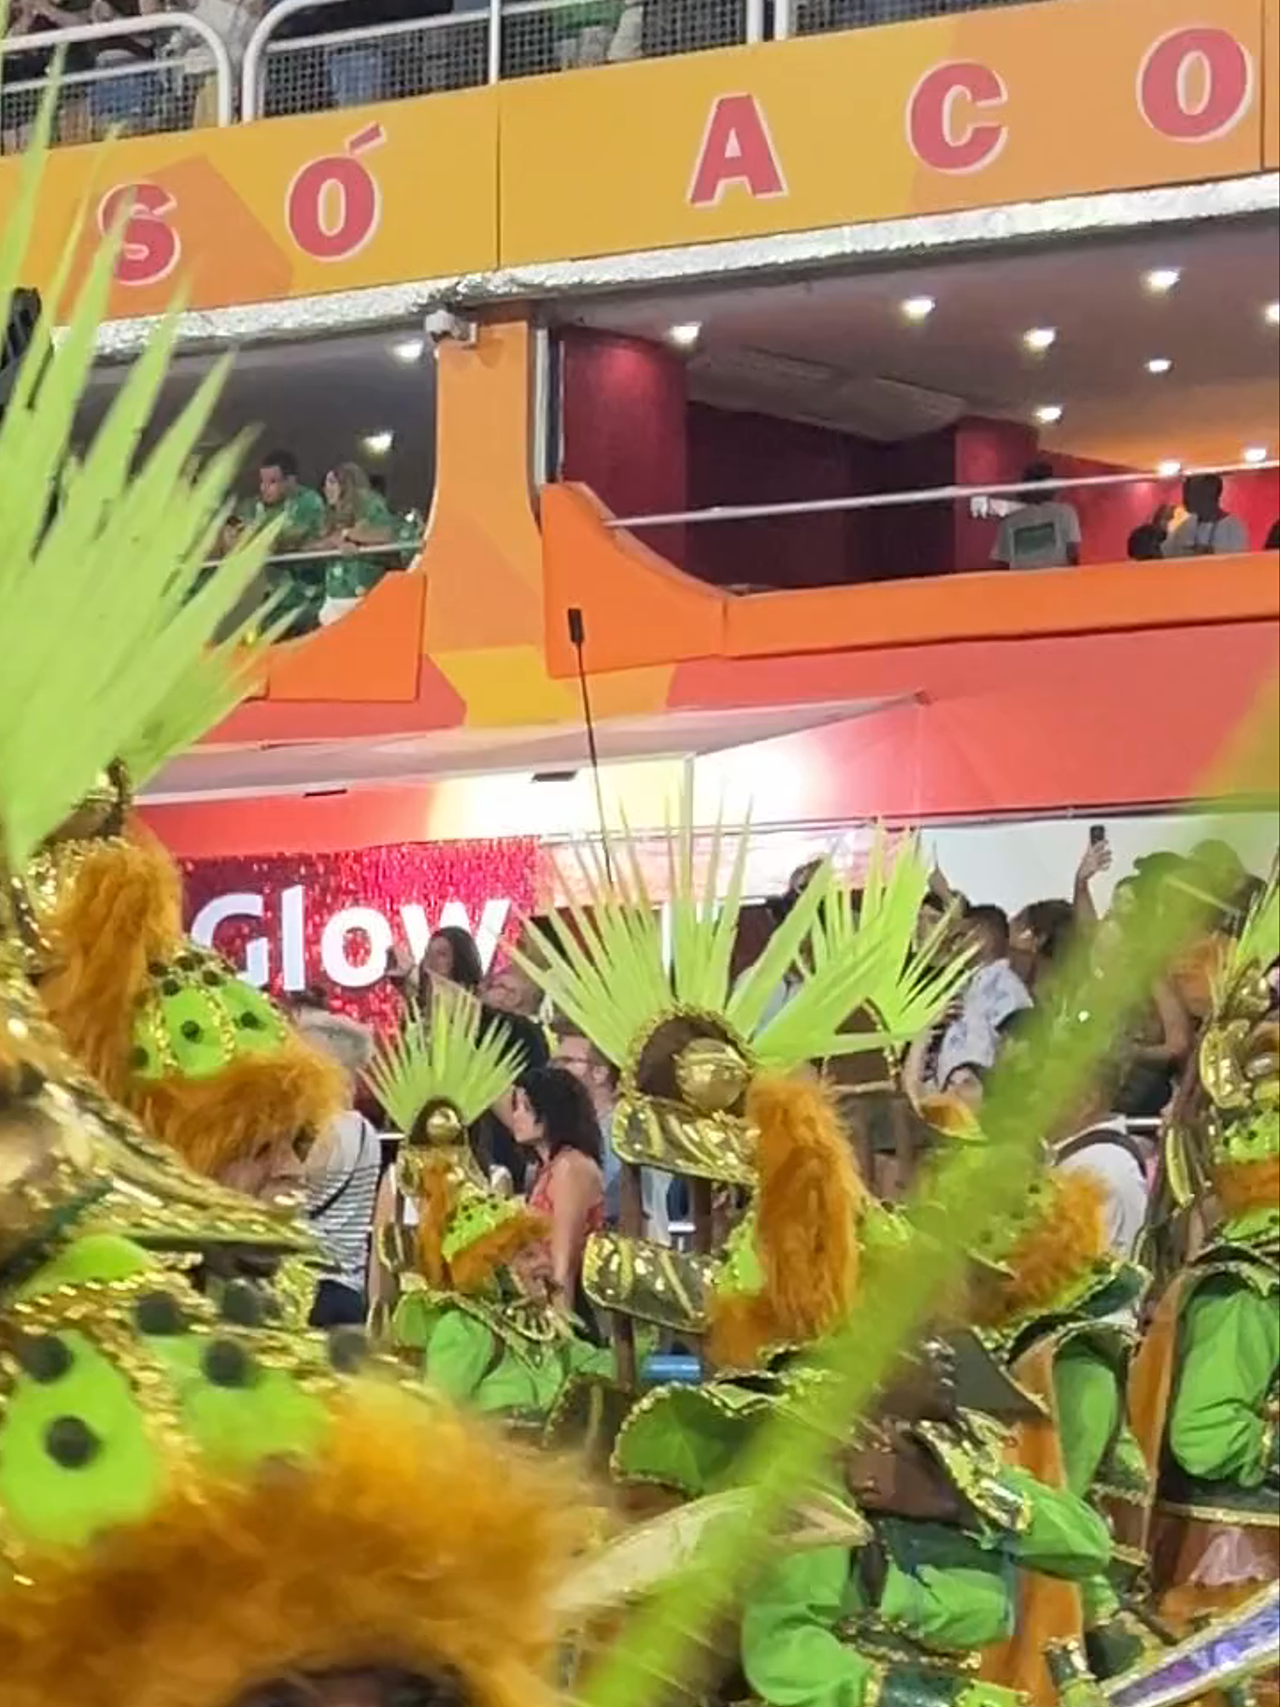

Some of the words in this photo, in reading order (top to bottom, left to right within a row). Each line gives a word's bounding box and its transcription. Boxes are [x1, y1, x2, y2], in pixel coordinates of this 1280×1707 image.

[96, 120, 387, 287] SÓ
[686, 26, 1253, 209] ACO
[190, 883, 512, 993] Glow
